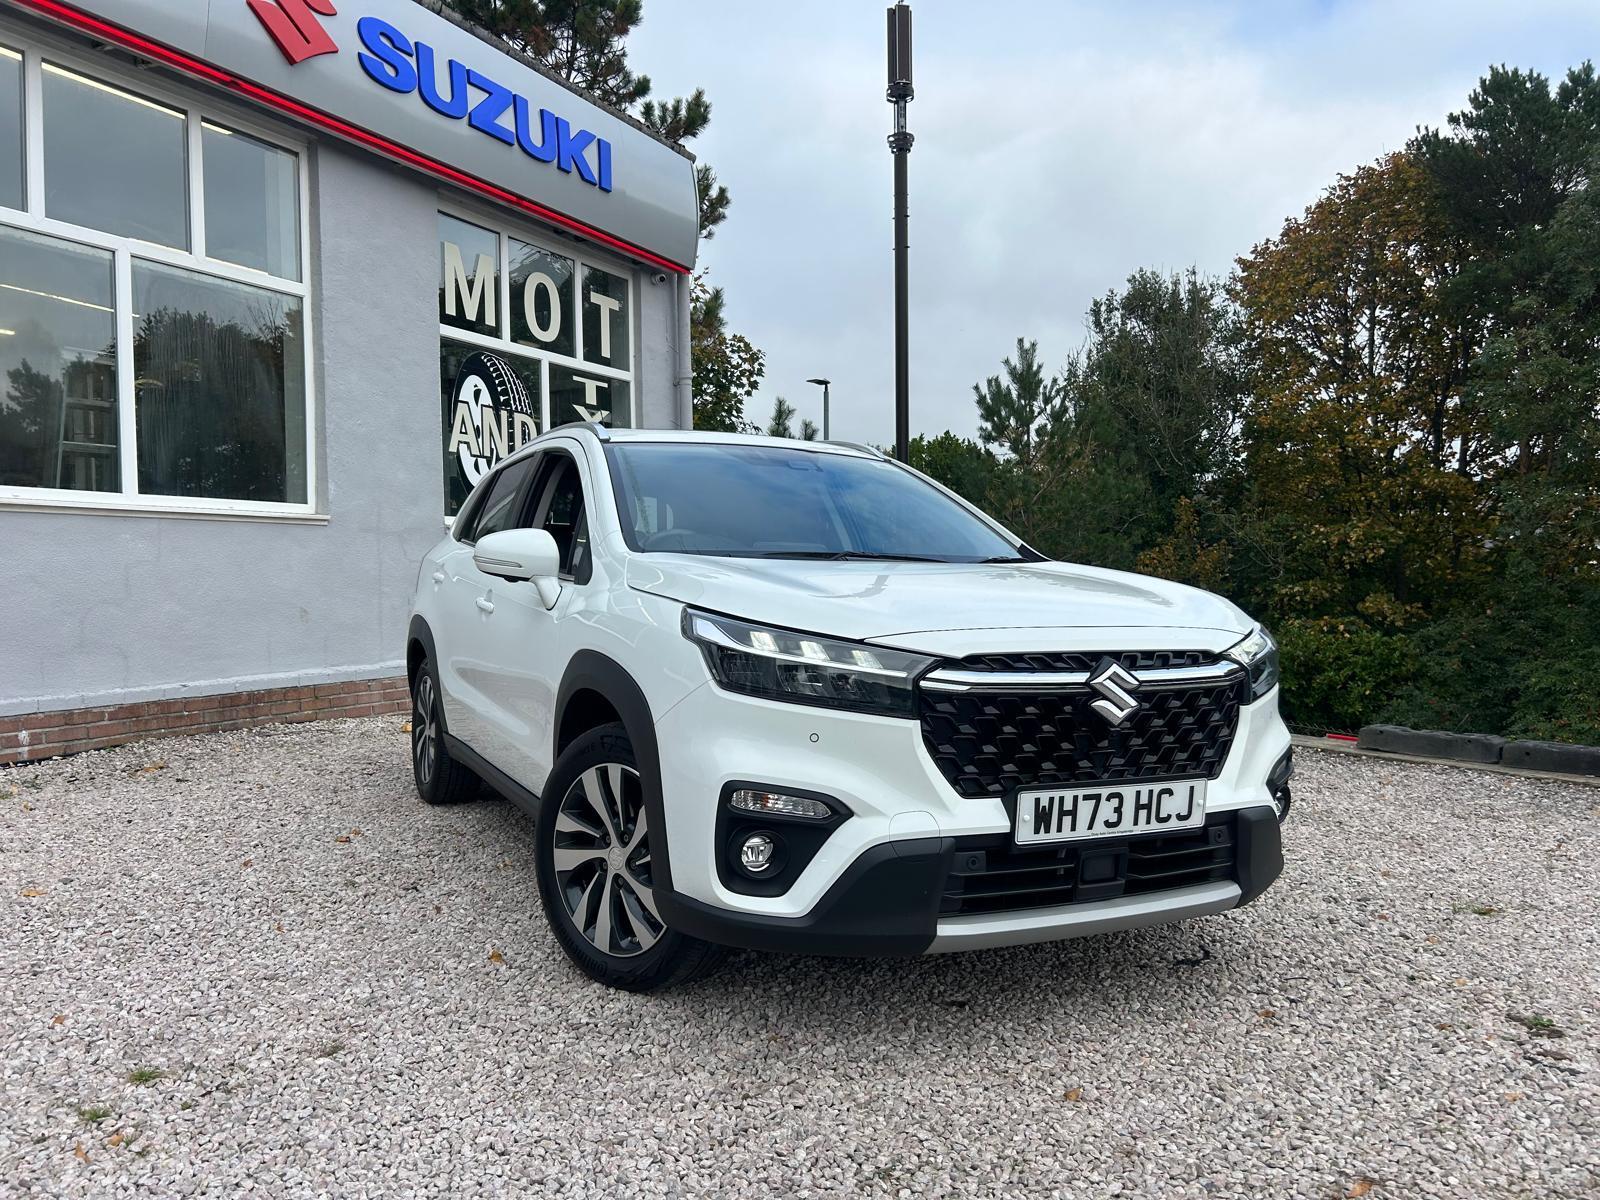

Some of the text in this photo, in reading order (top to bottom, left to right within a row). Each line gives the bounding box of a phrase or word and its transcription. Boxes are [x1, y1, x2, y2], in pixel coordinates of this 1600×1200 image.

[357, 16, 612, 193] SUZUKI
[440, 240, 621, 359] MOT
[448, 402, 538, 460] AND
[1033, 785, 1195, 835] WH73 HCJ
